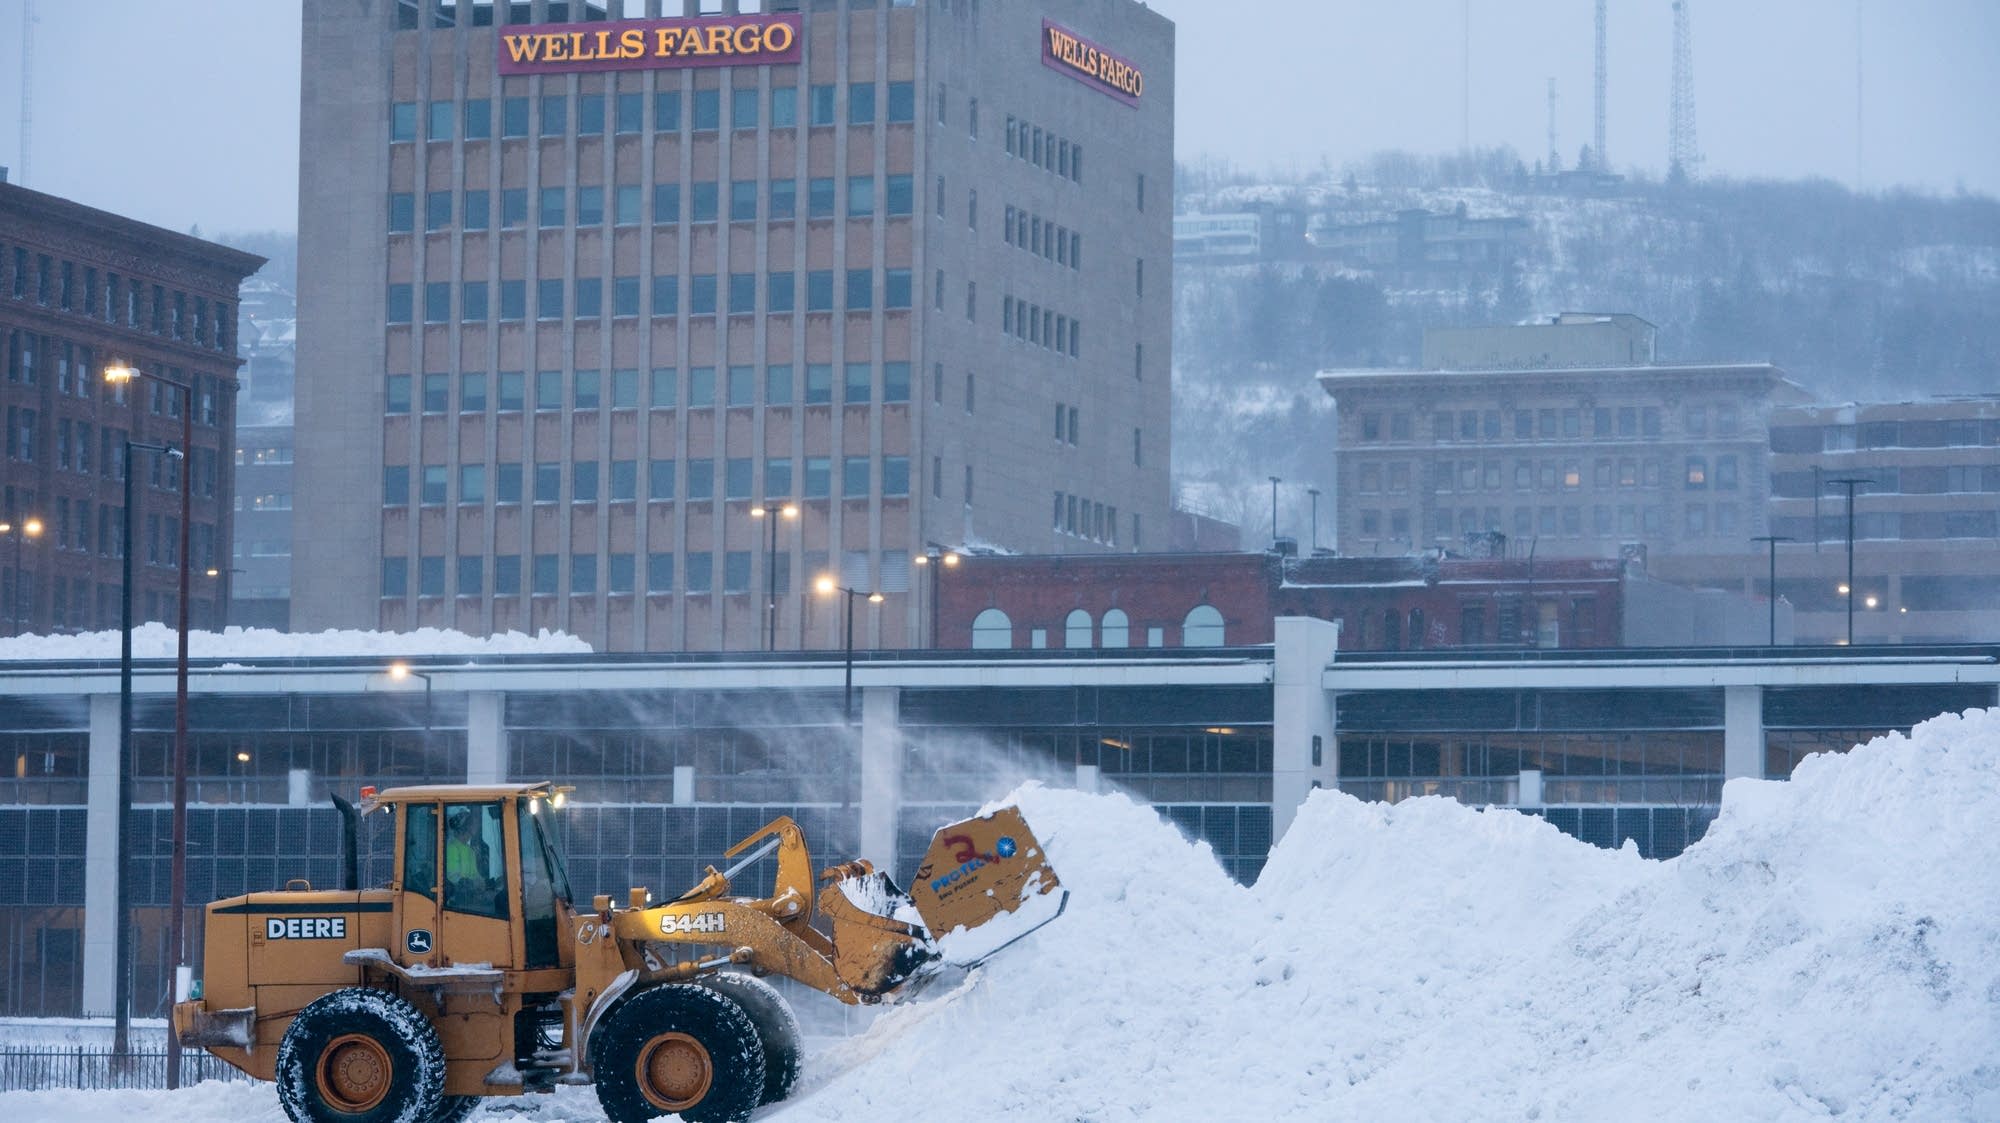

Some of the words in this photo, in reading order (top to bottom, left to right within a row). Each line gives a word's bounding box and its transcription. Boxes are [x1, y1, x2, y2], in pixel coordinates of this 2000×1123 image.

[503, 28, 645, 62] WELLS
[654, 22, 795, 57] FARGO
[1049, 28, 1097, 75] WELLS
[1099, 52, 1143, 97] FARGO
[943, 834, 1000, 864] 2
[267, 918, 345, 938] DEERE
[660, 912, 725, 934] 544H
